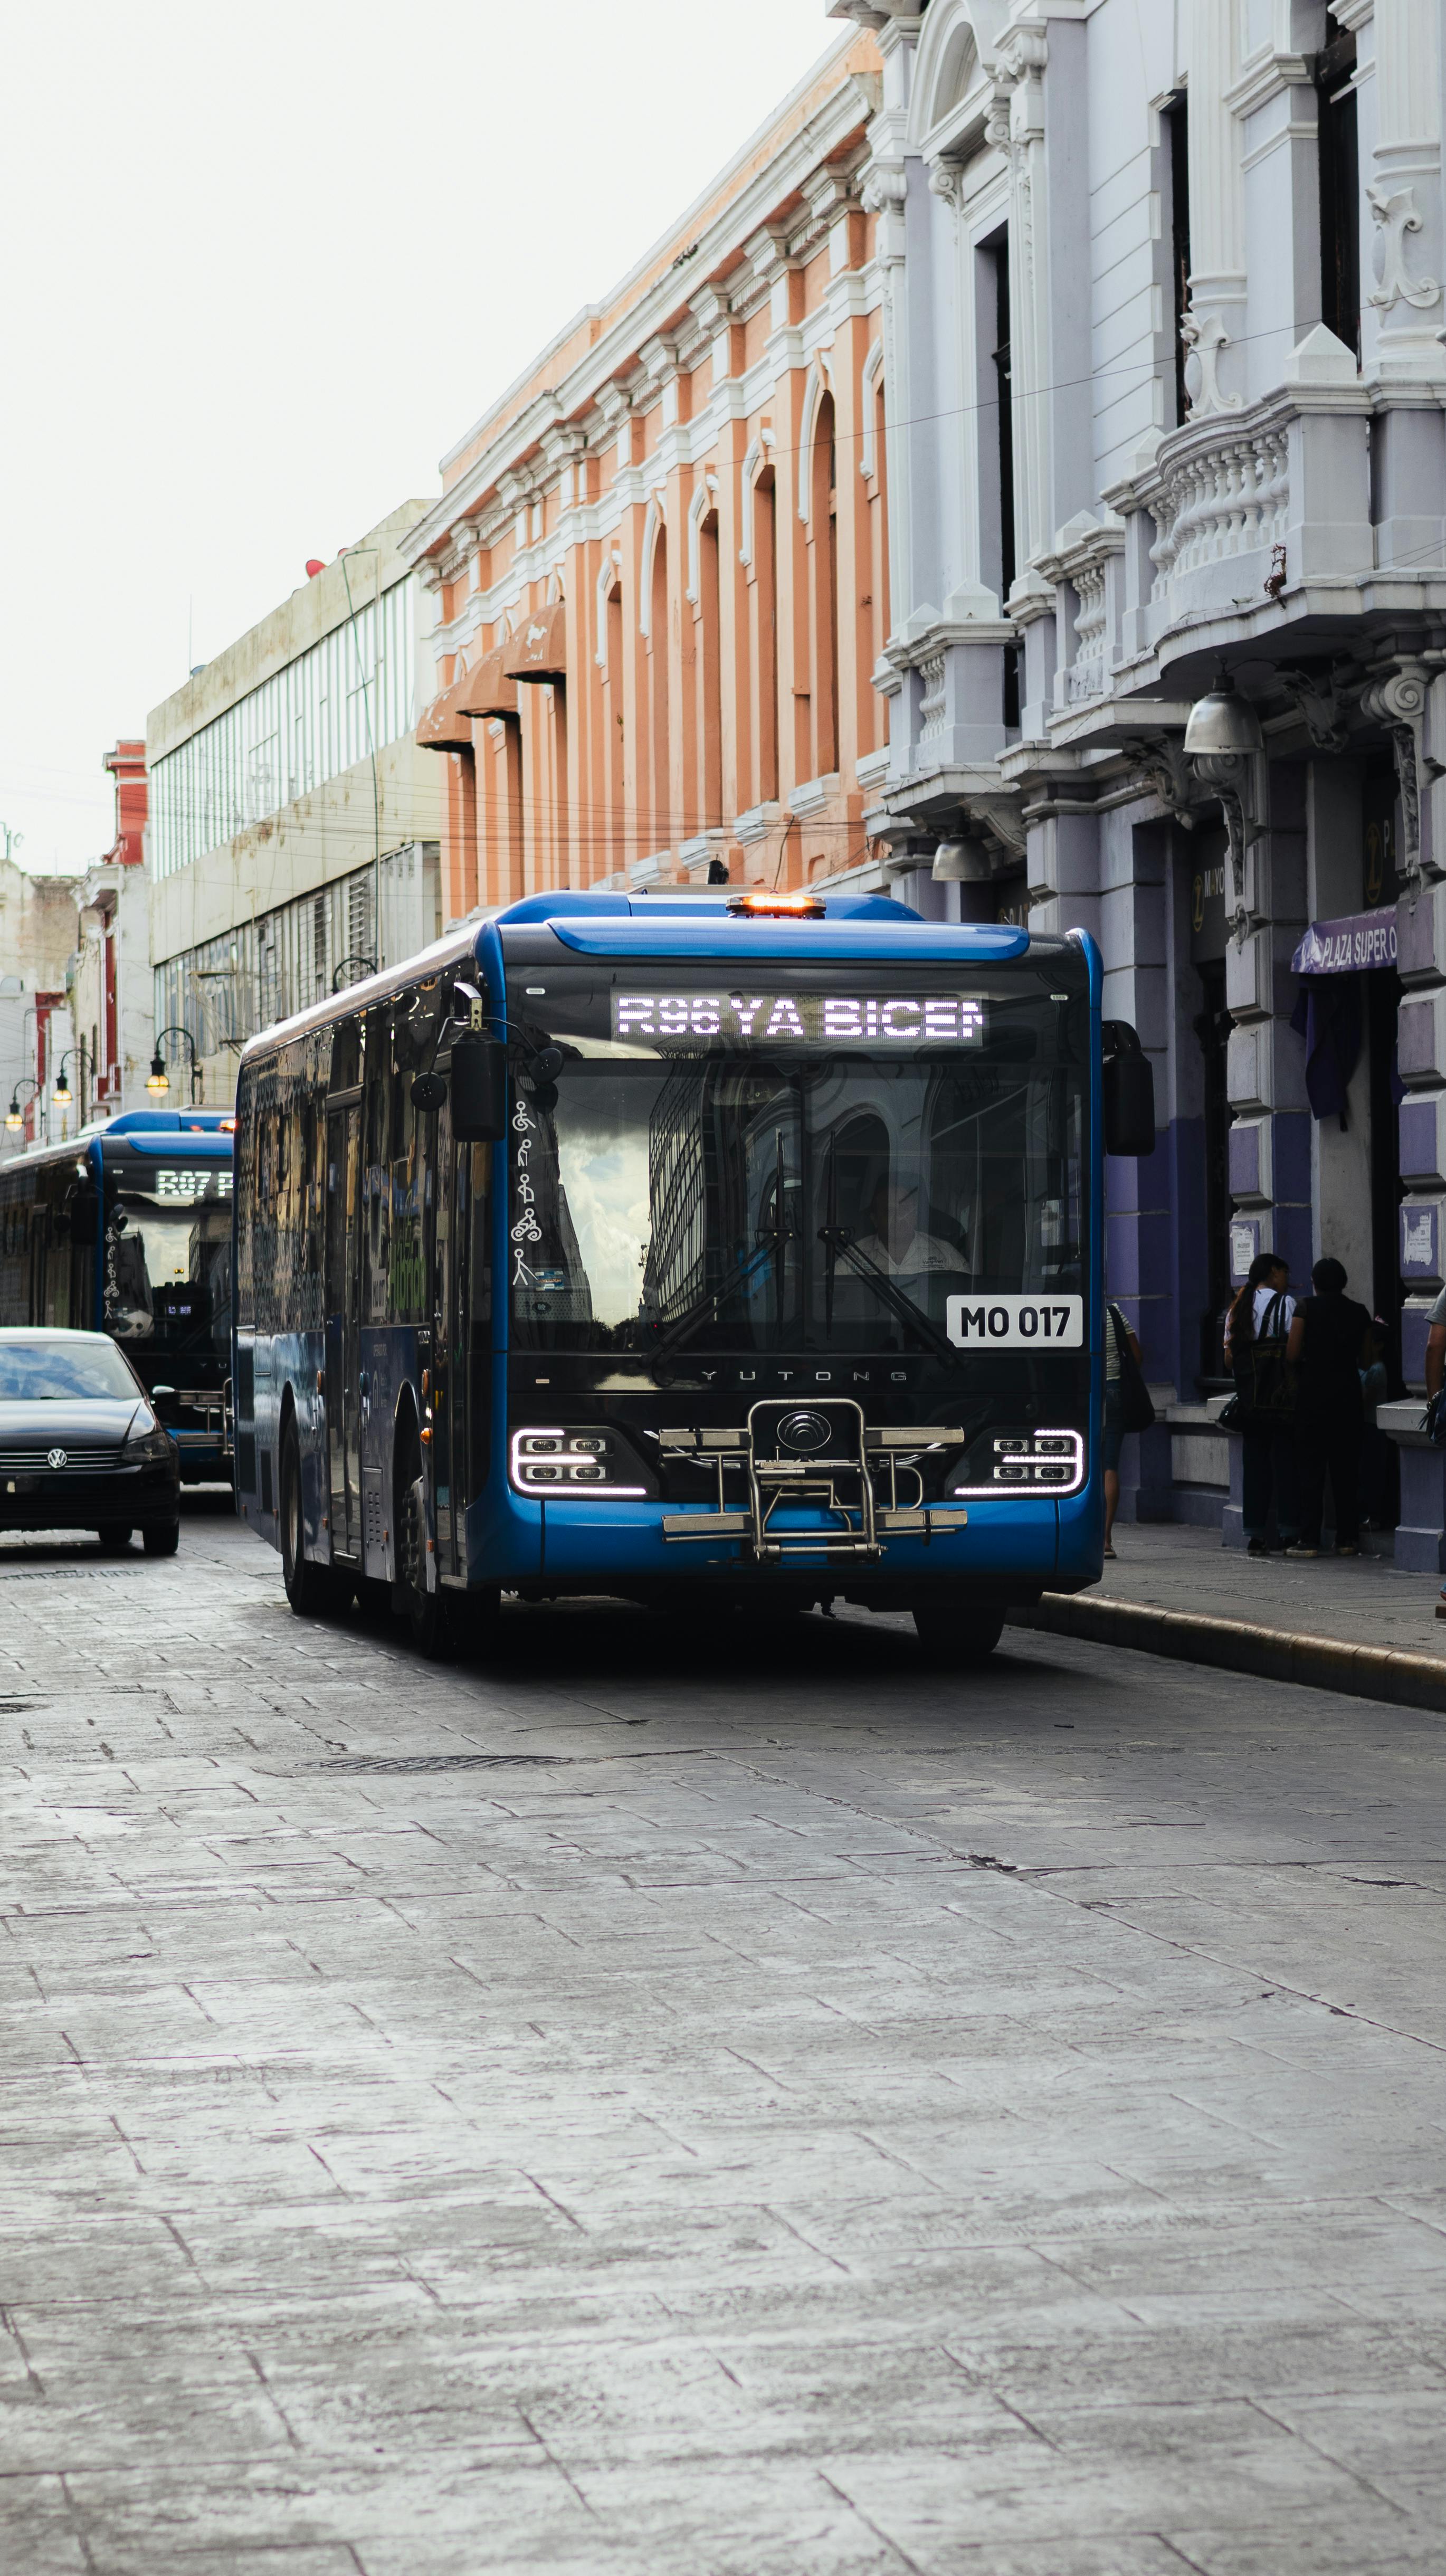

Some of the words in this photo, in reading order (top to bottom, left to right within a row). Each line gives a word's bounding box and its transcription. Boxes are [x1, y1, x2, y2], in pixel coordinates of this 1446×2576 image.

[1320, 935, 1352, 967] PLAZA
[1354, 928, 1388, 964] SUPER
[731, 999, 804, 1035] YA
[961, 1307, 1009, 1337] MO
[1019, 1306, 1071, 1337] 017
[701, 1371, 907, 1381] YUTONG
